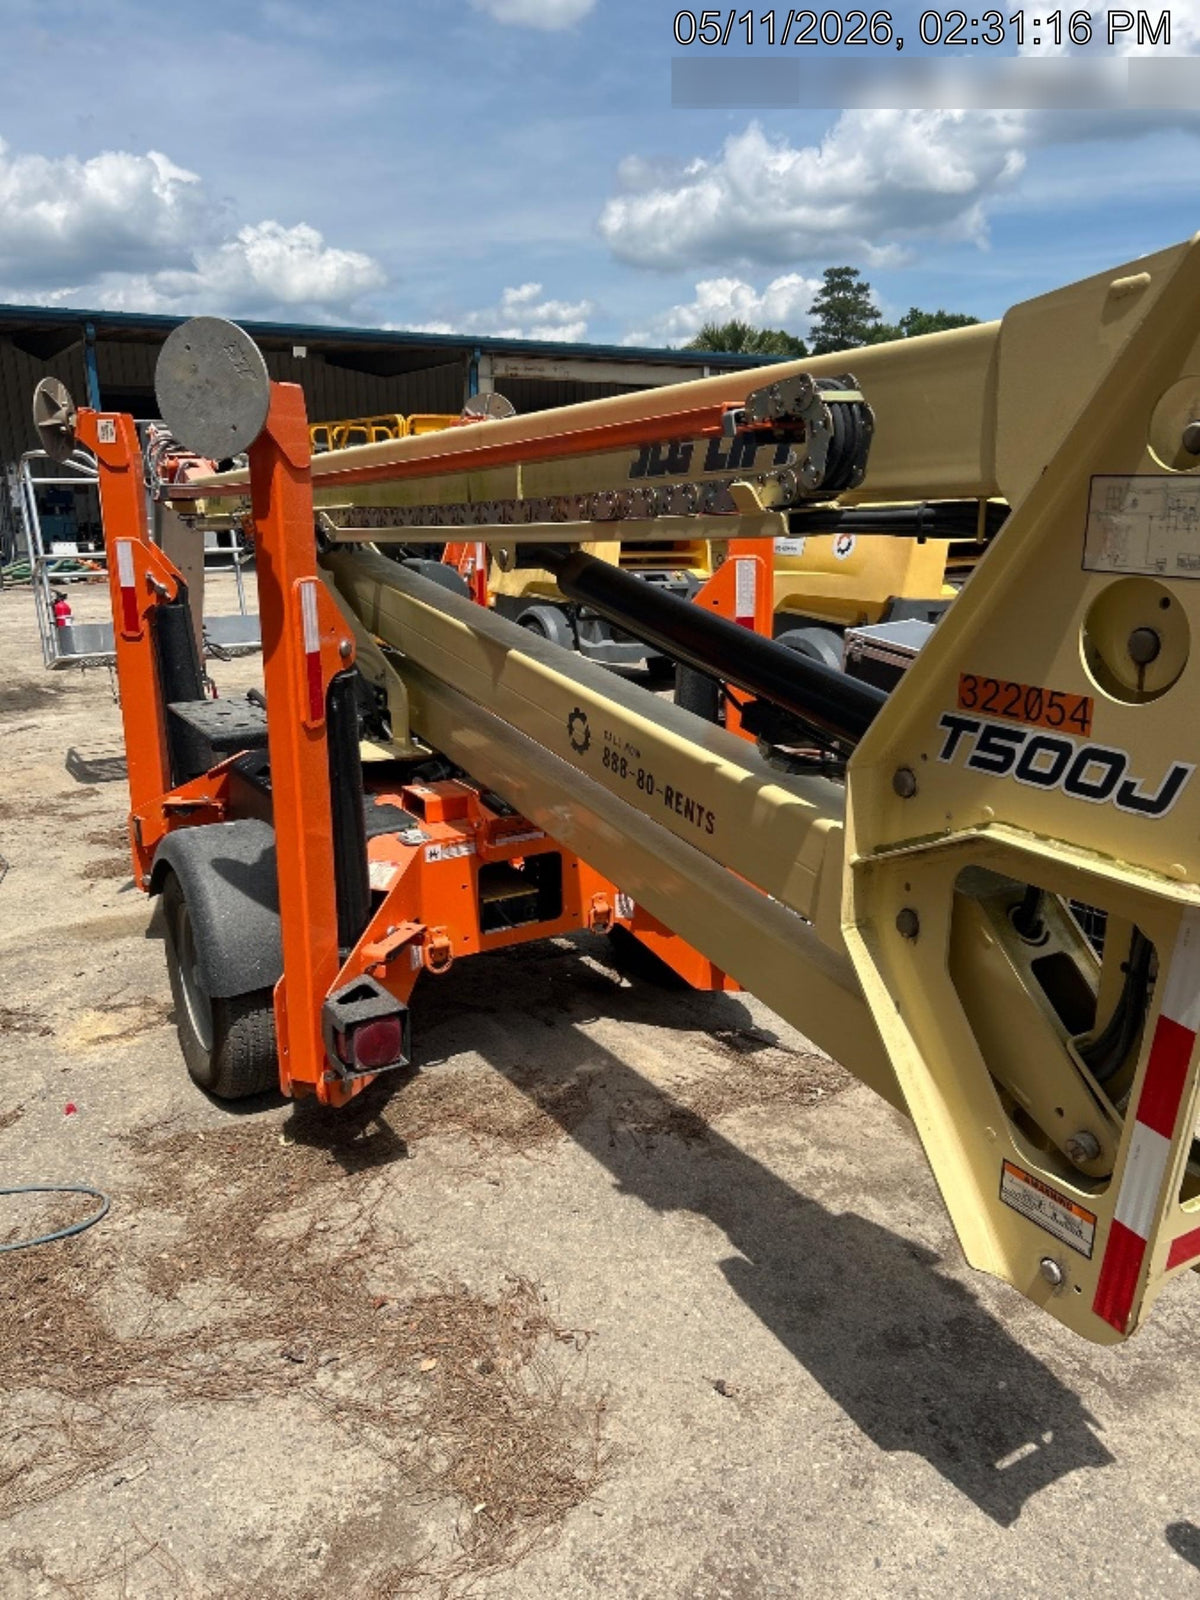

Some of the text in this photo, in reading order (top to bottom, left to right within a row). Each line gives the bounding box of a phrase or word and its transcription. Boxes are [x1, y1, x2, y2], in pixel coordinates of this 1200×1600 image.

[960, 673, 1091, 733] 322054
[601, 746, 716, 835] 888-80-RENTS
[937, 711, 1197, 818] T500J
